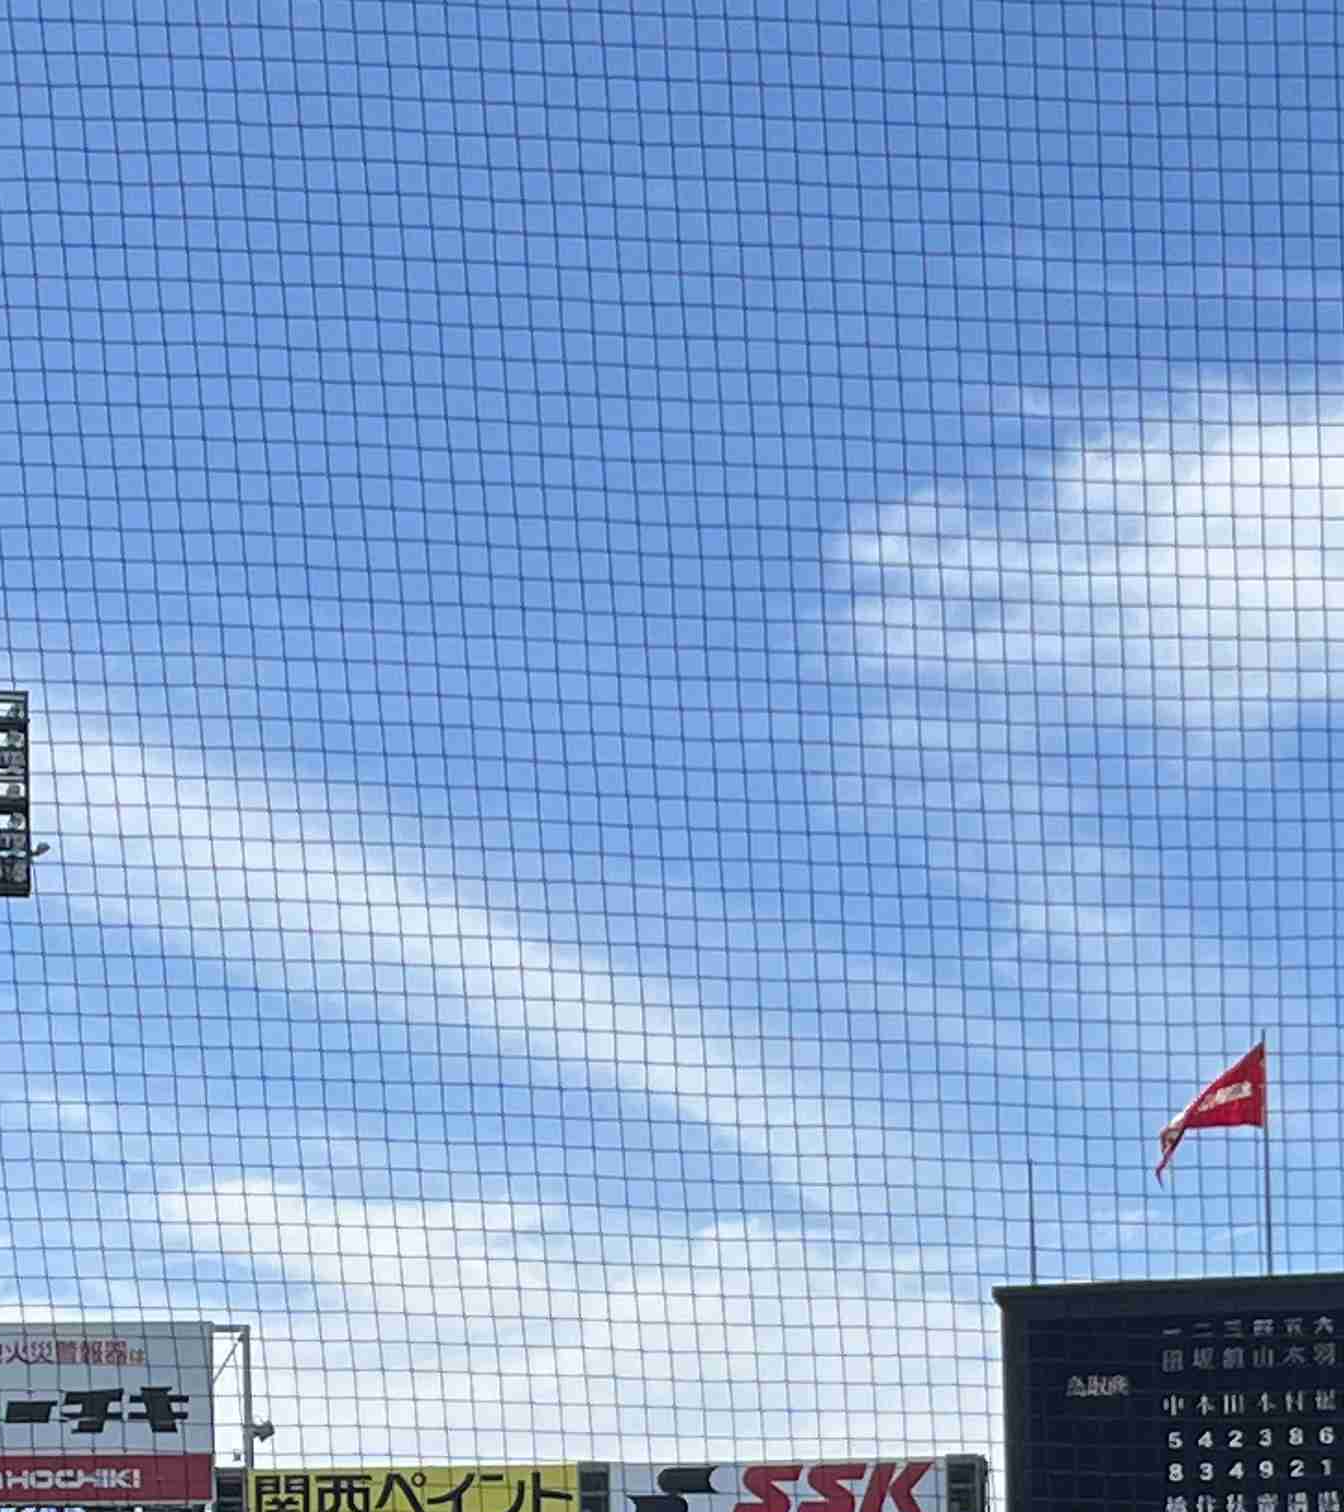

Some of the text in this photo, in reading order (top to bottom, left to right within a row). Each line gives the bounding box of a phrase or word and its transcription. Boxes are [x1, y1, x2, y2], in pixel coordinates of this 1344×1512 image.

[1169, 1432, 1183, 1449] 5
[1198, 1431, 1213, 1448] 4
[1229, 1430, 1243, 1447] 2
[1259, 1429, 1272, 1446] 3
[1289, 1428, 1303, 1445] 8
[1319, 1427, 1334, 1444] 6
[7, 1467, 141, 1490] HOCHIKI
[1169, 1463, 1183, 1481] 8
[1199, 1463, 1213, 1480] 3
[1229, 1462, 1244, 1479] 4
[1259, 1461, 1273, 1478] 9
[1290, 1460, 1304, 1477] 2
[1321, 1459, 1332, 1476] 1
